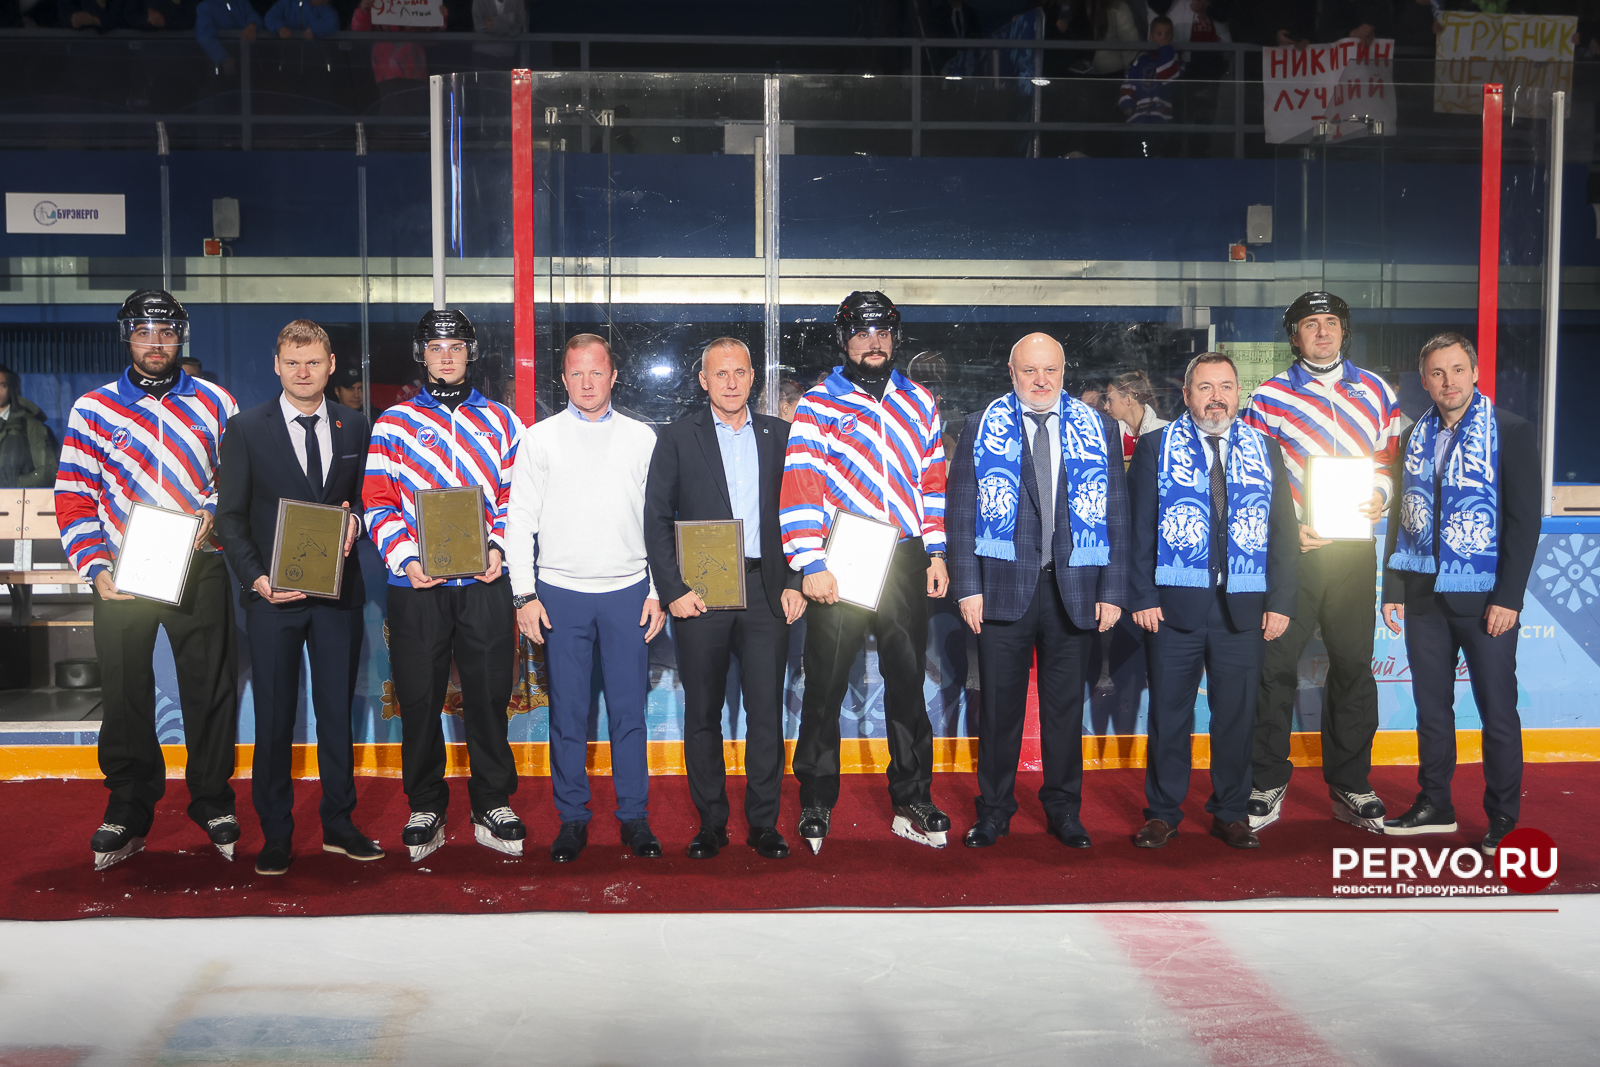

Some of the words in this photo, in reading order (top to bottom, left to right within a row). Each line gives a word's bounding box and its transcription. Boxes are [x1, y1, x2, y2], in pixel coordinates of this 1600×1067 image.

[1446, 20, 1576, 57] ТРУБНИК
[1270, 41, 1391, 79] НИКИТИН
[1273, 73, 1385, 112] ЛУЧШИЙ
[57, 209, 99, 220] БУРЭНЕРГО
[139, 375, 174, 387] CCM
